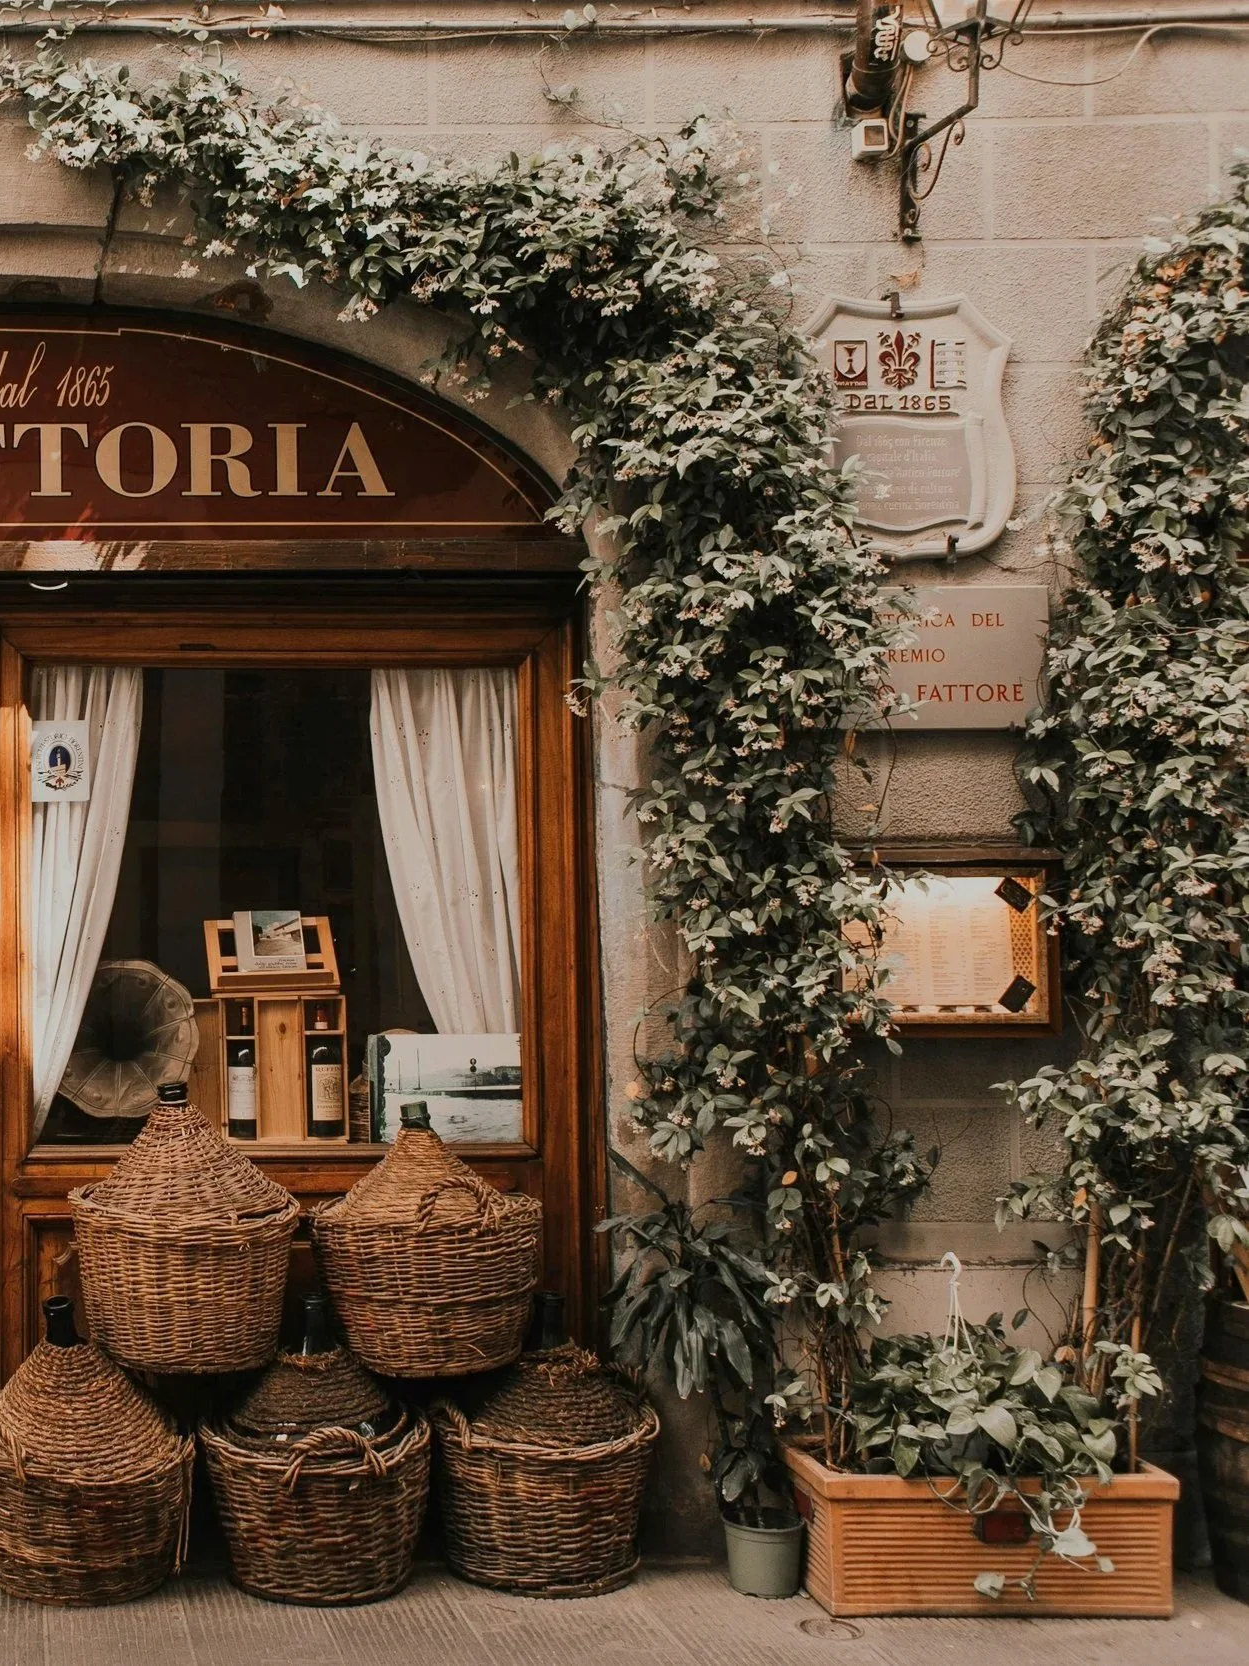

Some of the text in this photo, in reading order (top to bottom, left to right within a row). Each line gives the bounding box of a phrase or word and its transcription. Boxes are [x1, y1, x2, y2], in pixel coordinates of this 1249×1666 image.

[57, 365, 114, 408] 1865
[900, 394, 951, 410] 1865
[972, 613, 1005, 627] DEL
[917, 684, 1024, 702] FATTORE
